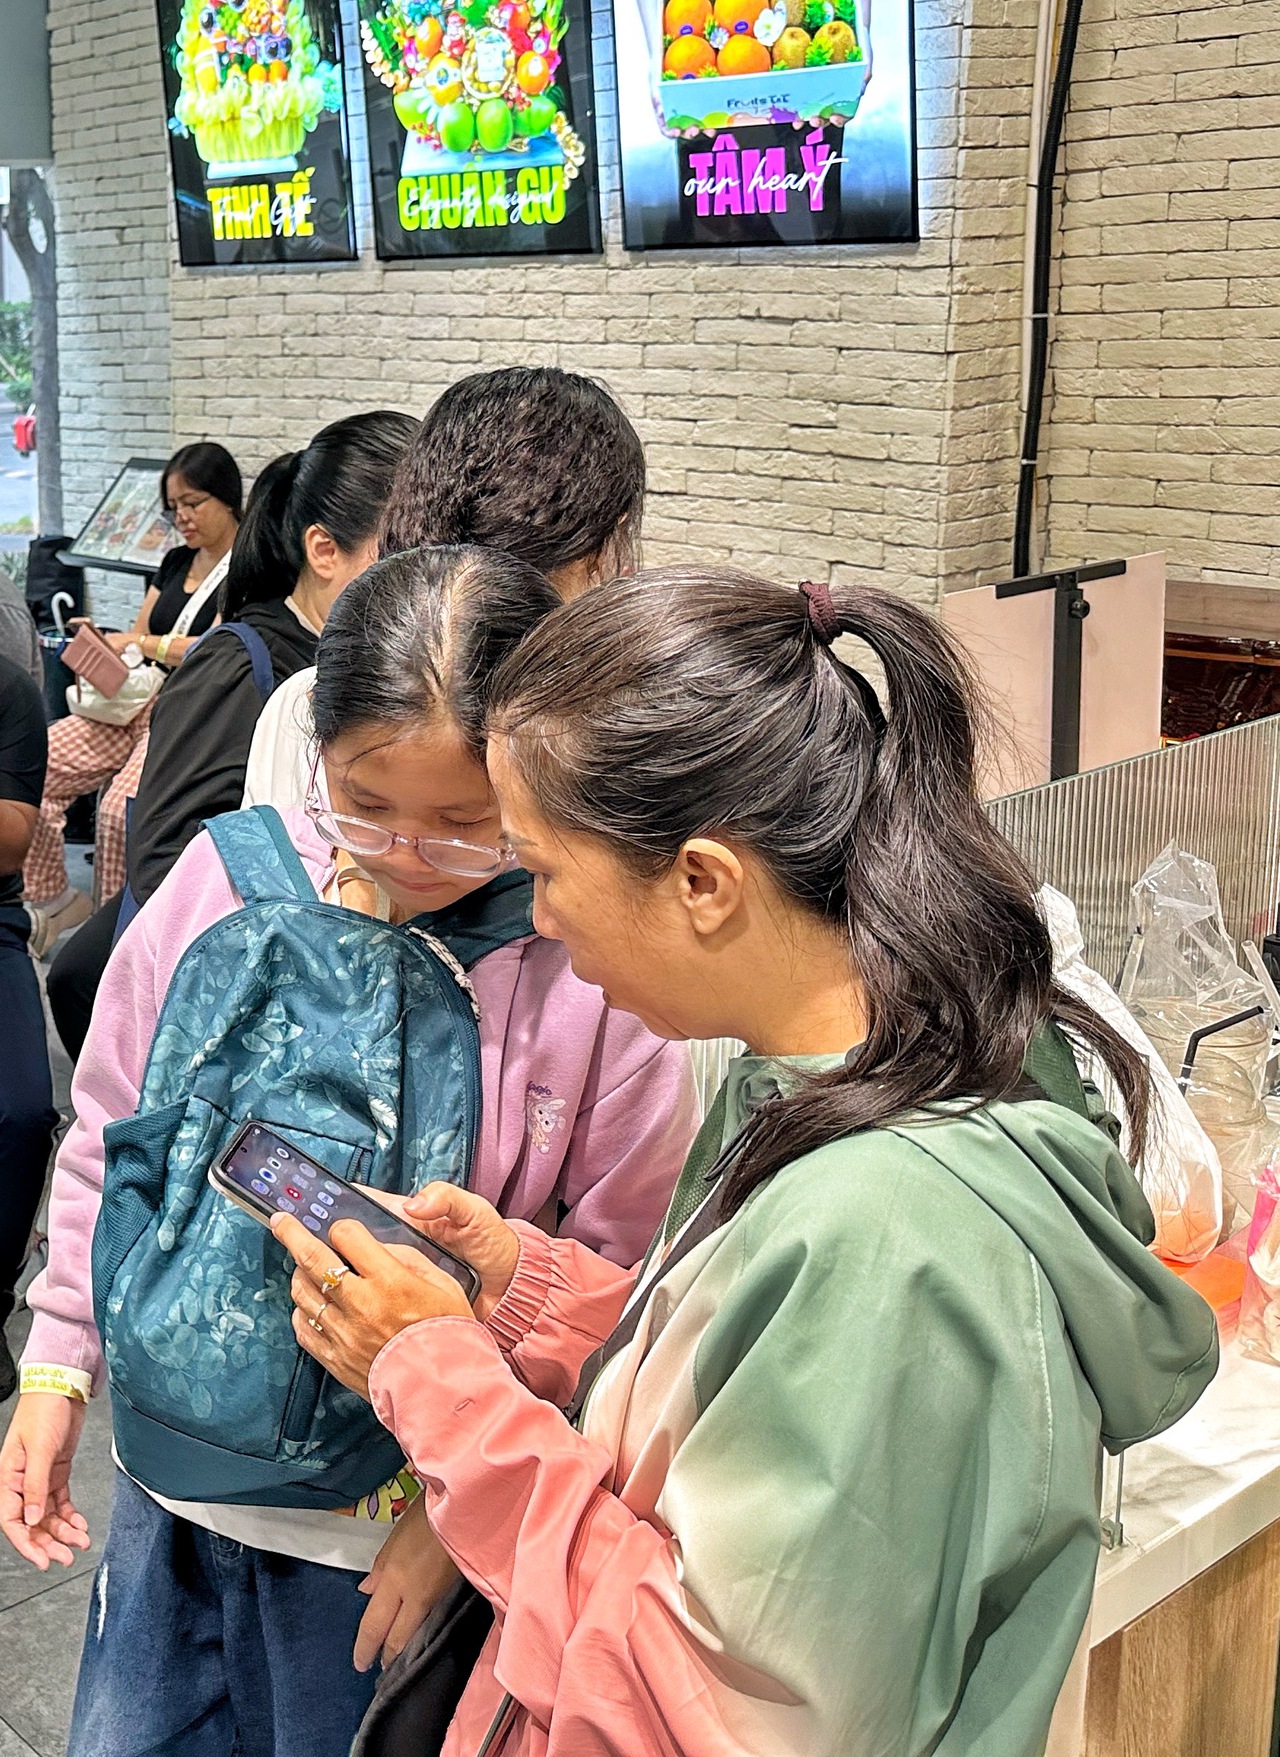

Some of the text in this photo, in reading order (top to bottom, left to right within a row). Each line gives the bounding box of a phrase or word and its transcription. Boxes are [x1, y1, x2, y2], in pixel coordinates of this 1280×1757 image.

[206, 166, 316, 241] TINH TẾ
[517, 165, 567, 227] GU
[684, 151, 850, 202] our heart
[689, 127, 831, 217] TÂM Ý
